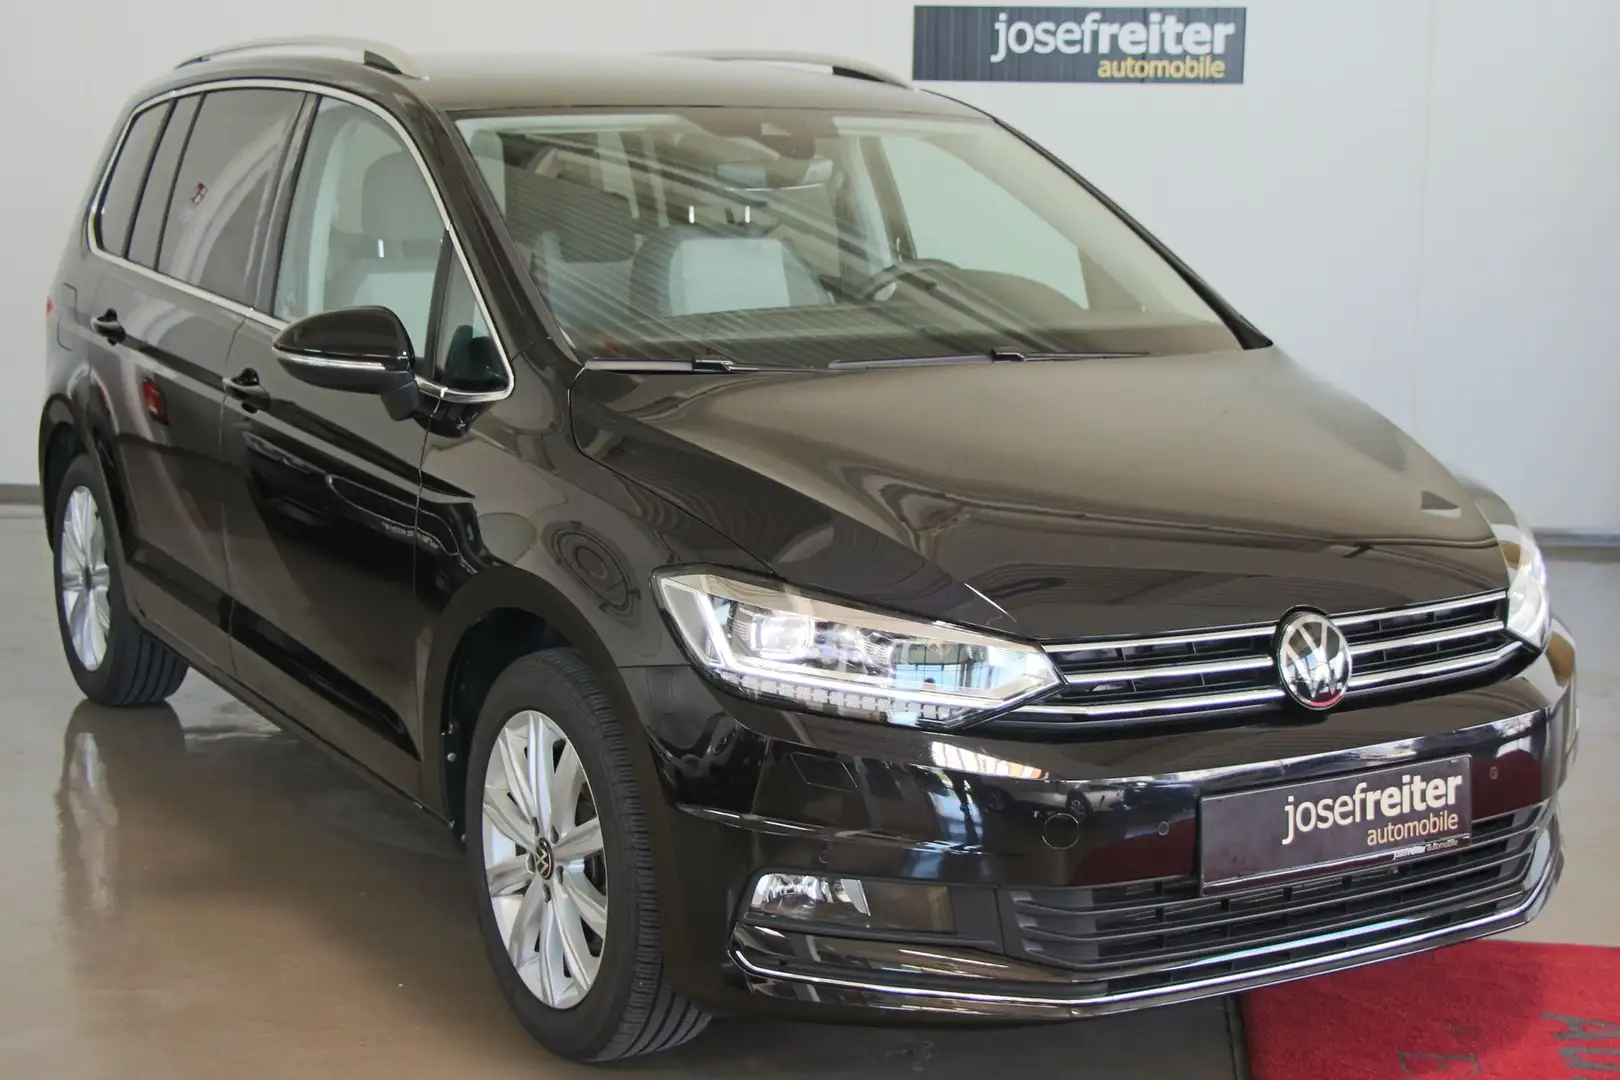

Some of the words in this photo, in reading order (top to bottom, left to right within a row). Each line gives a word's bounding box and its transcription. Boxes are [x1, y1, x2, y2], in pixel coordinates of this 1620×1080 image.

[990, 12, 1236, 63] josefreiter
[1098, 55, 1226, 79] automobile
[1282, 773, 1463, 845] josefreiter
[1366, 810, 1459, 846] automobile
